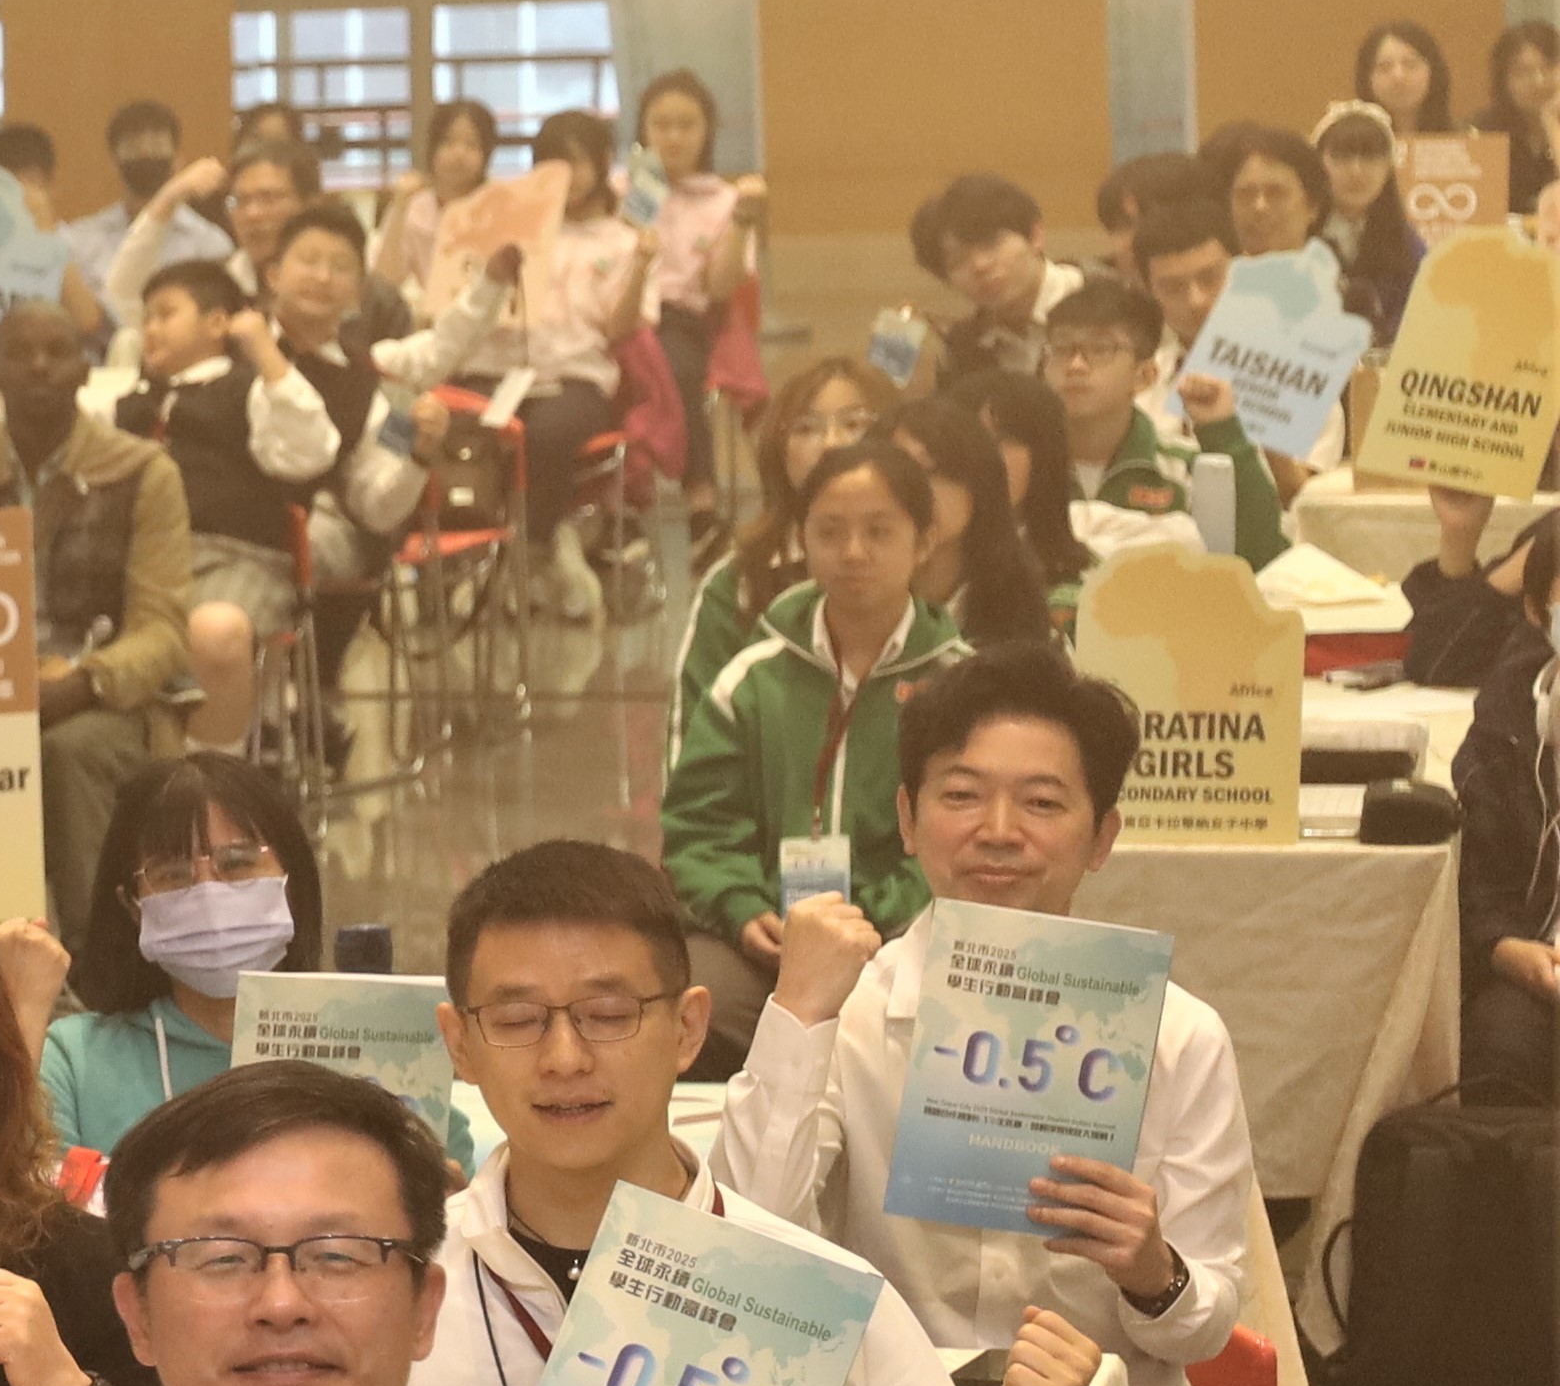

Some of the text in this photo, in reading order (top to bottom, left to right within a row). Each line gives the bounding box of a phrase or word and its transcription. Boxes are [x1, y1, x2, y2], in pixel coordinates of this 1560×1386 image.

[1209, 335, 1329, 398] TAISHAN
[1401, 369, 1542, 418] QINGSHAN
[1144, 712, 1266, 741] RATINA
[1133, 750, 1235, 779] GIRLS
[1203, 786, 1272, 804] SCHOOL
[951, 953, 1141, 996] 全球永續 Global Sustainable
[319, 1027, 359, 1041] Global
[362, 1029, 436, 1044] Sustainable
[934, 1024, 1120, 1103] -0.5°C
[625, 1232, 698, 1268] 新北市2025
[609, 1271, 738, 1333] 學生行動高峰會
[616, 1248, 832, 1342] 全球永續 Global Sustainable
